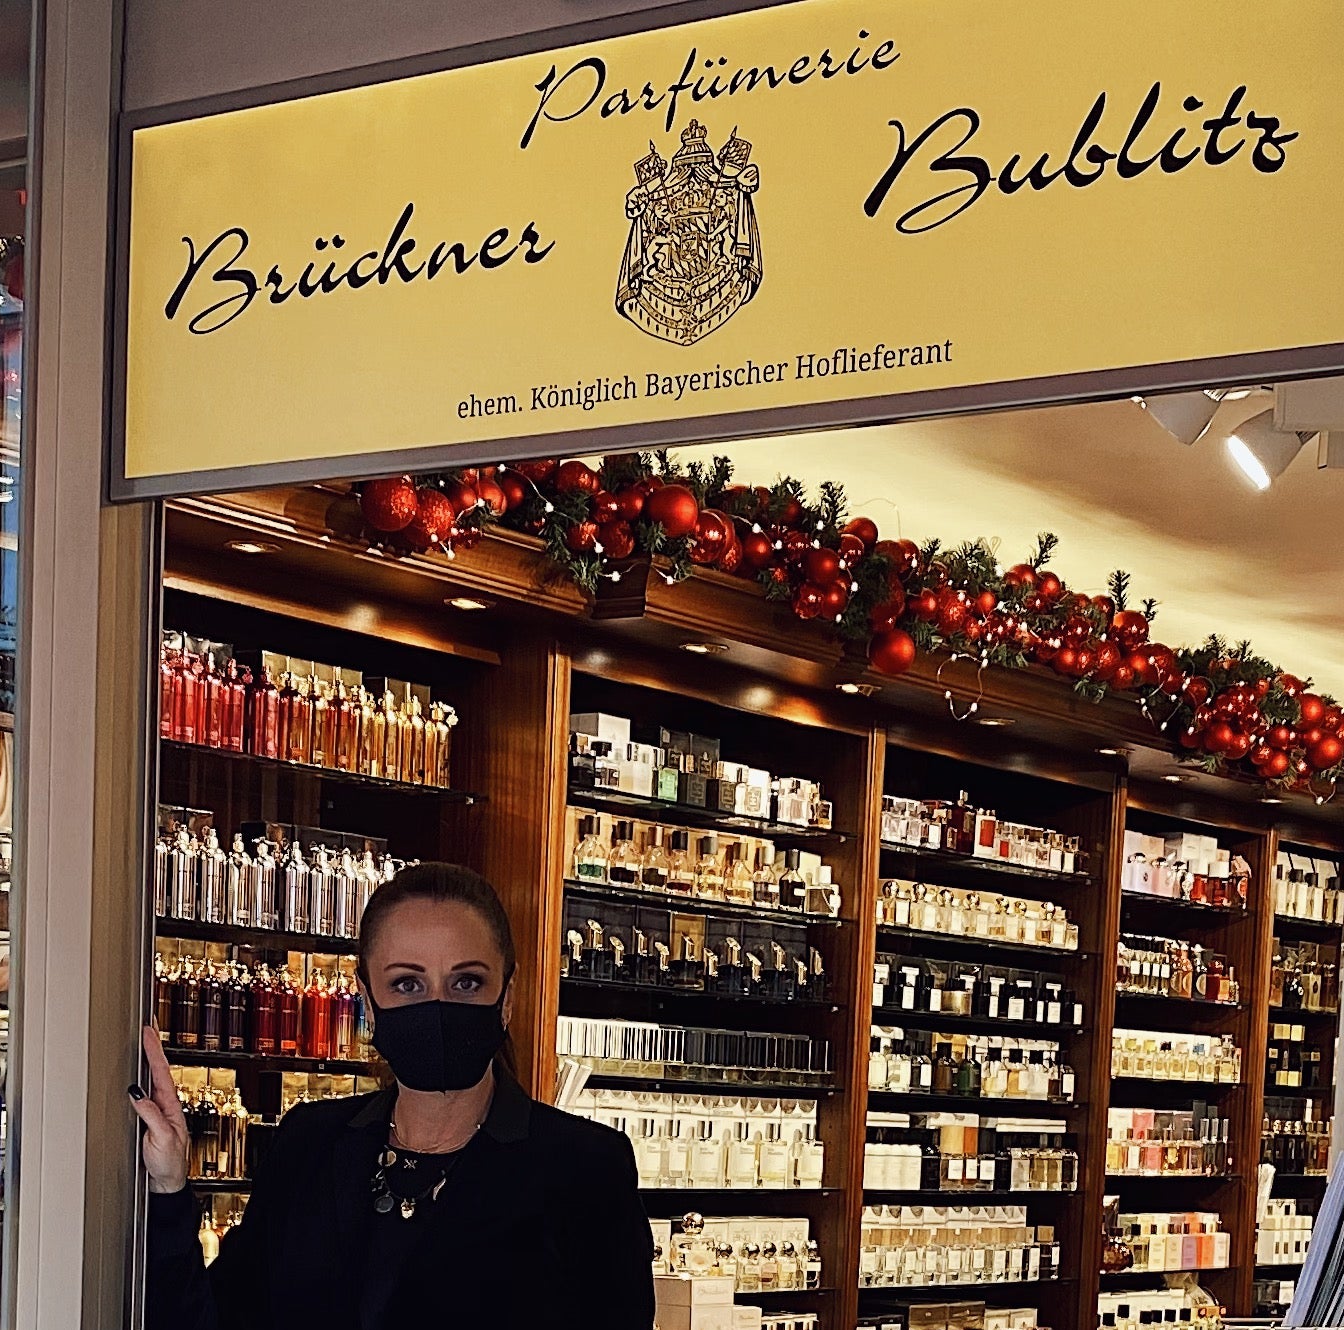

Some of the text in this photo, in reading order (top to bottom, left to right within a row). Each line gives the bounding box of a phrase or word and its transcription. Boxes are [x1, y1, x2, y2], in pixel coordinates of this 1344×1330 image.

[521, 31, 901, 149] Parfümerie
[864, 82, 1299, 235] Bublitz
[165, 203, 556, 335] Brückner
[457, 338, 955, 419] ehem. Königlich Bayerischer Hoflieferant
